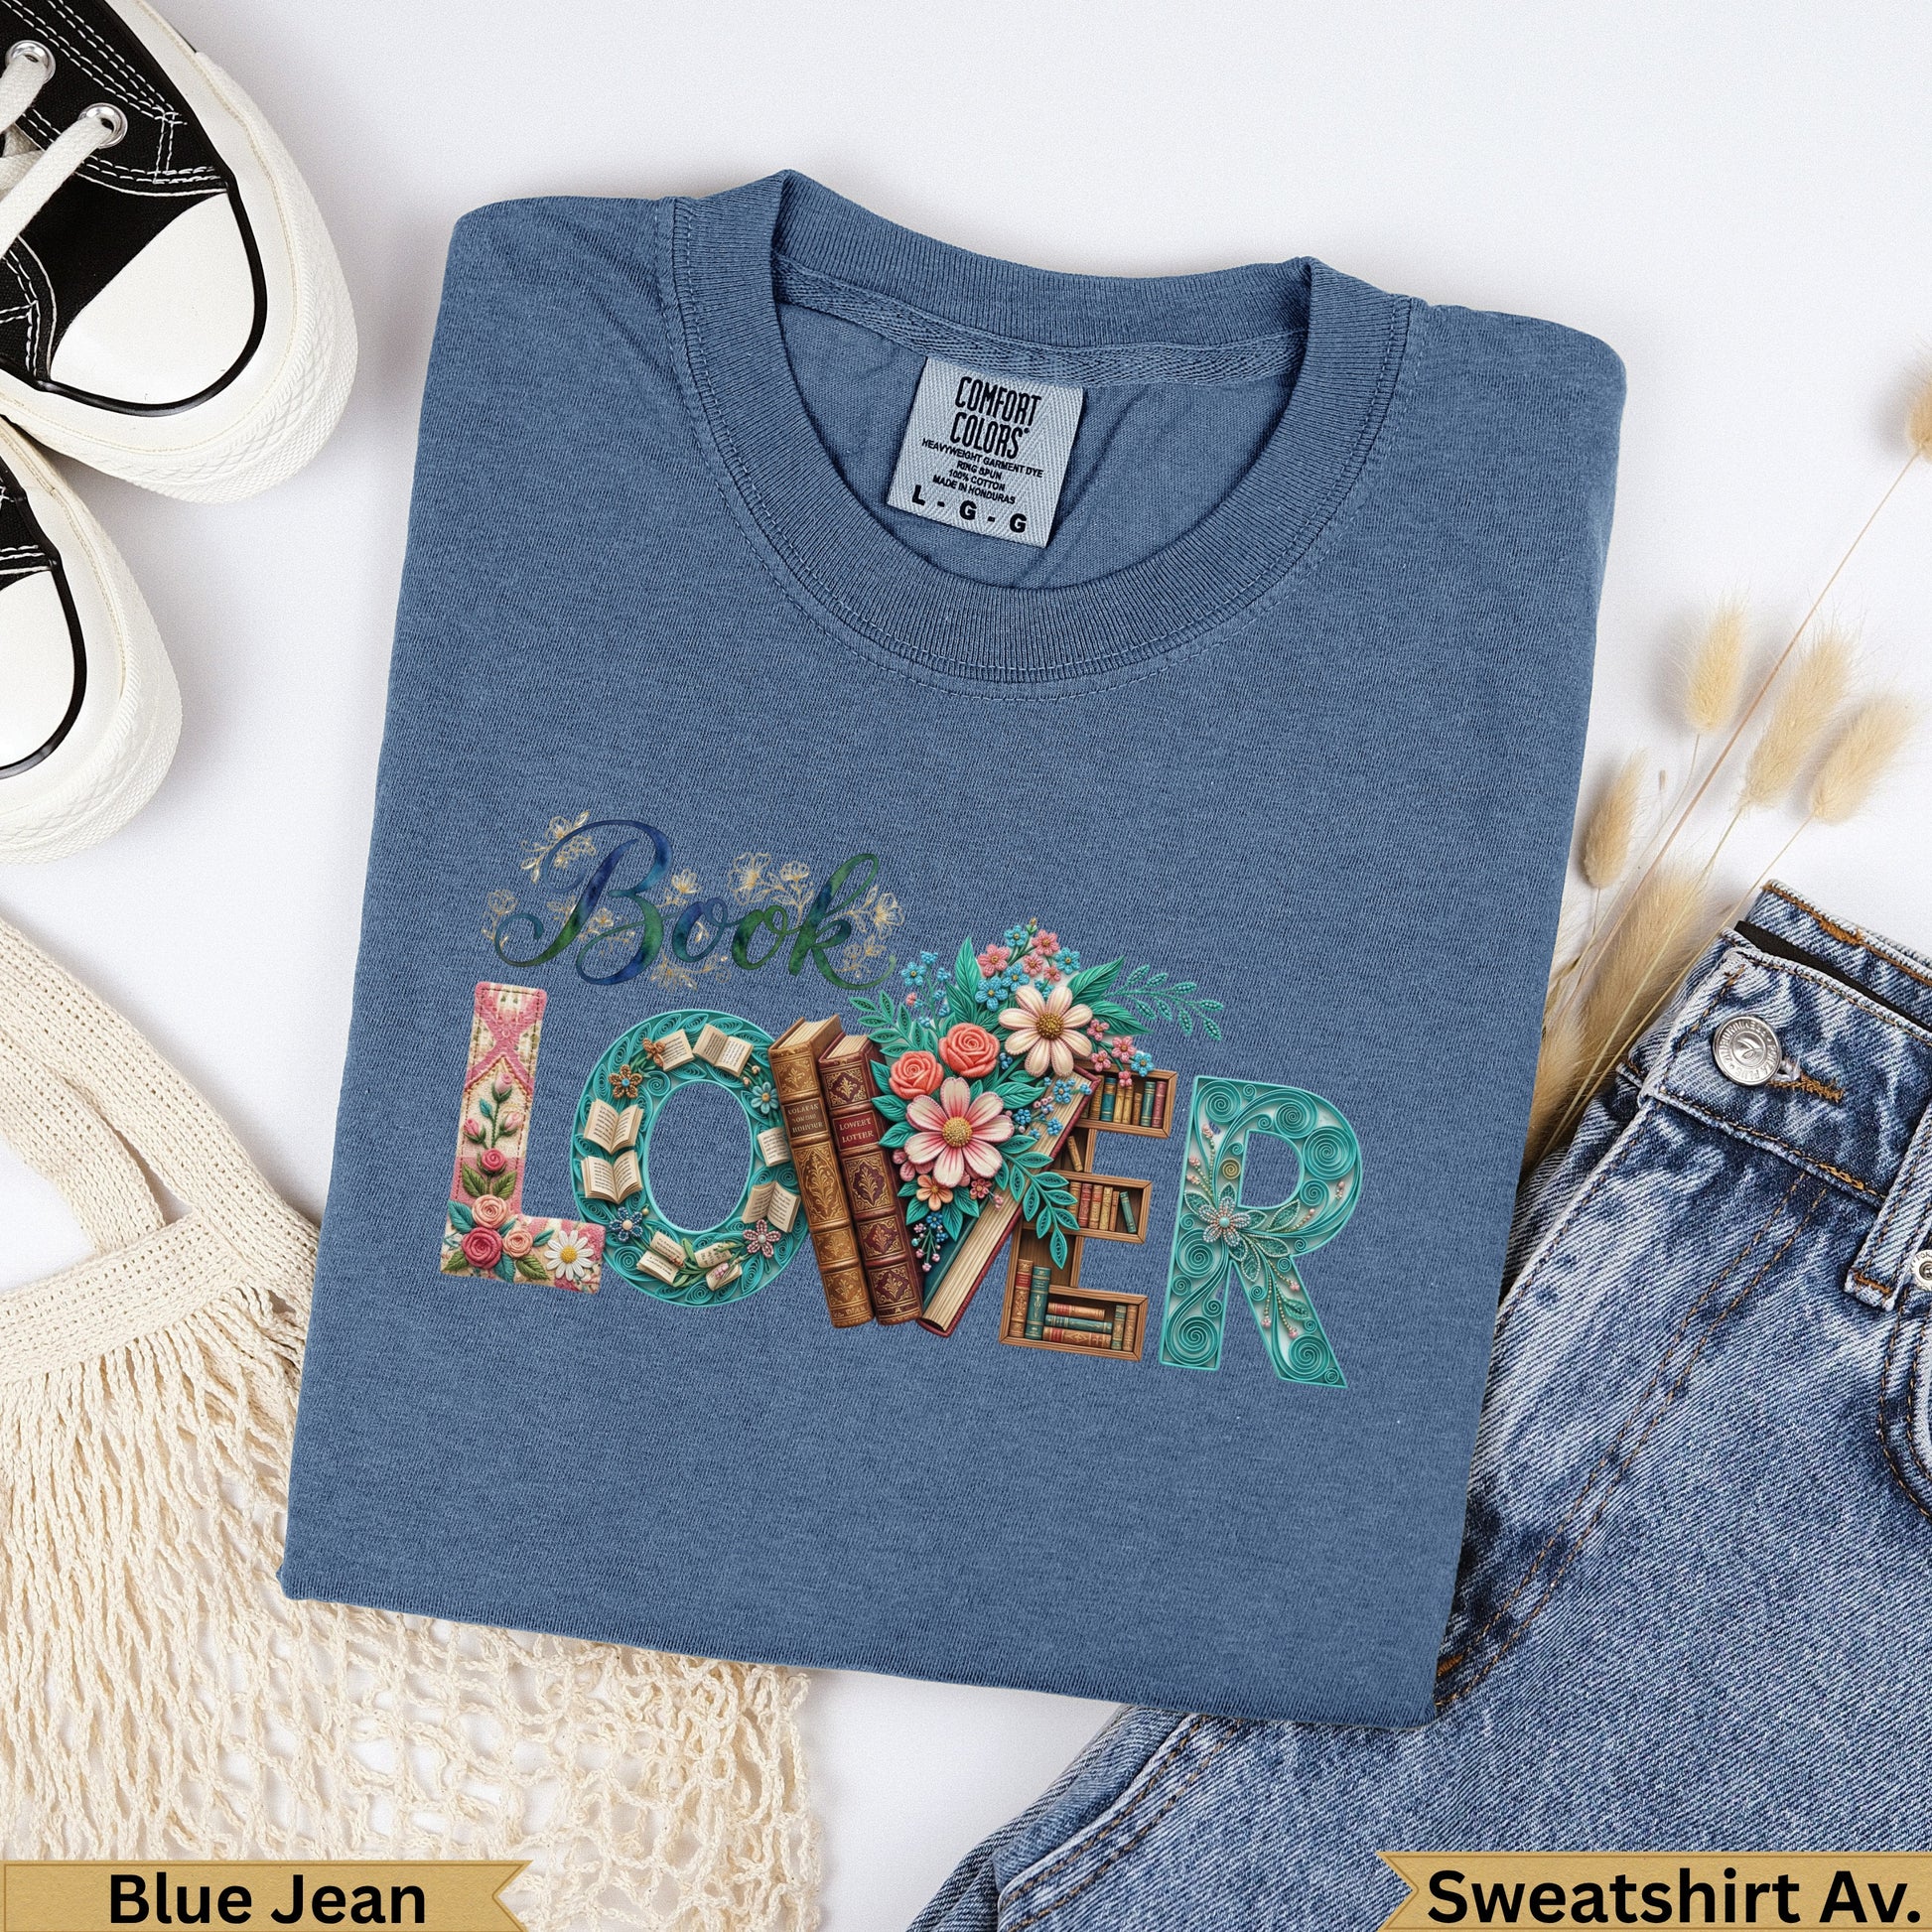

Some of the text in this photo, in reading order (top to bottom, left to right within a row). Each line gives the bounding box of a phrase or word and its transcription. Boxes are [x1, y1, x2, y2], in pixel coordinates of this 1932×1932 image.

[954, 375, 1042, 427] COMFORT
[921, 438, 1044, 479] HEAVYWEIGHT GARMENT DYE
[956, 460, 1003, 481] RING SPUN
[932, 475, 1017, 505] MADE IN HONDURAS
[949, 469, 1006, 492] 100% COTTON
[494, 818, 896, 991] Book
[439, 977, 1363, 1389] LOVER
